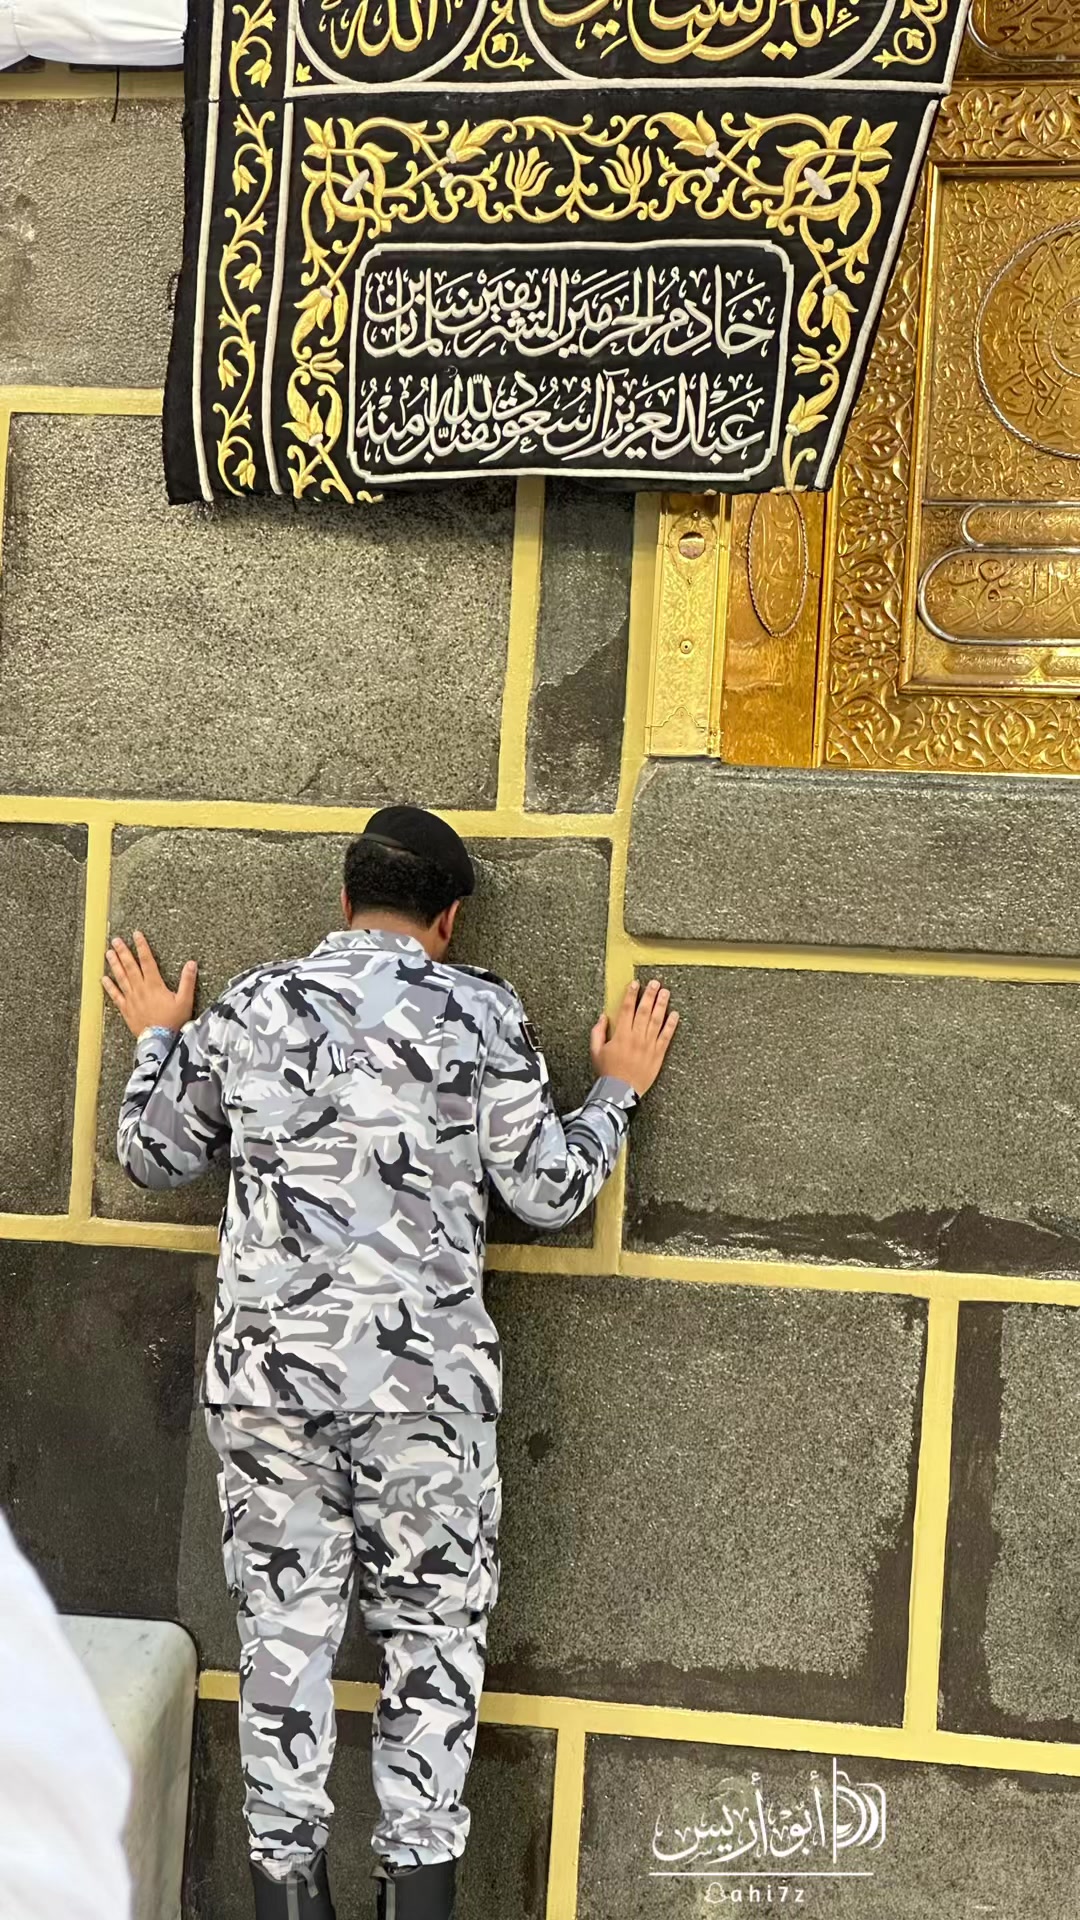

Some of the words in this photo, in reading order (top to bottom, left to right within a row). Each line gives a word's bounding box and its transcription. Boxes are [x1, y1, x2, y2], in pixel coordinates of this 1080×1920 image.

[362, 266, 485, 359] سلمان
[434, 266, 570, 359] الشريفين
[515, 264, 666, 359] الحرمين
[628, 264, 776, 359] خادم
[356, 386, 426, 452] منه
[424, 373, 494, 441] الله
[479, 370, 592, 464] سعود
